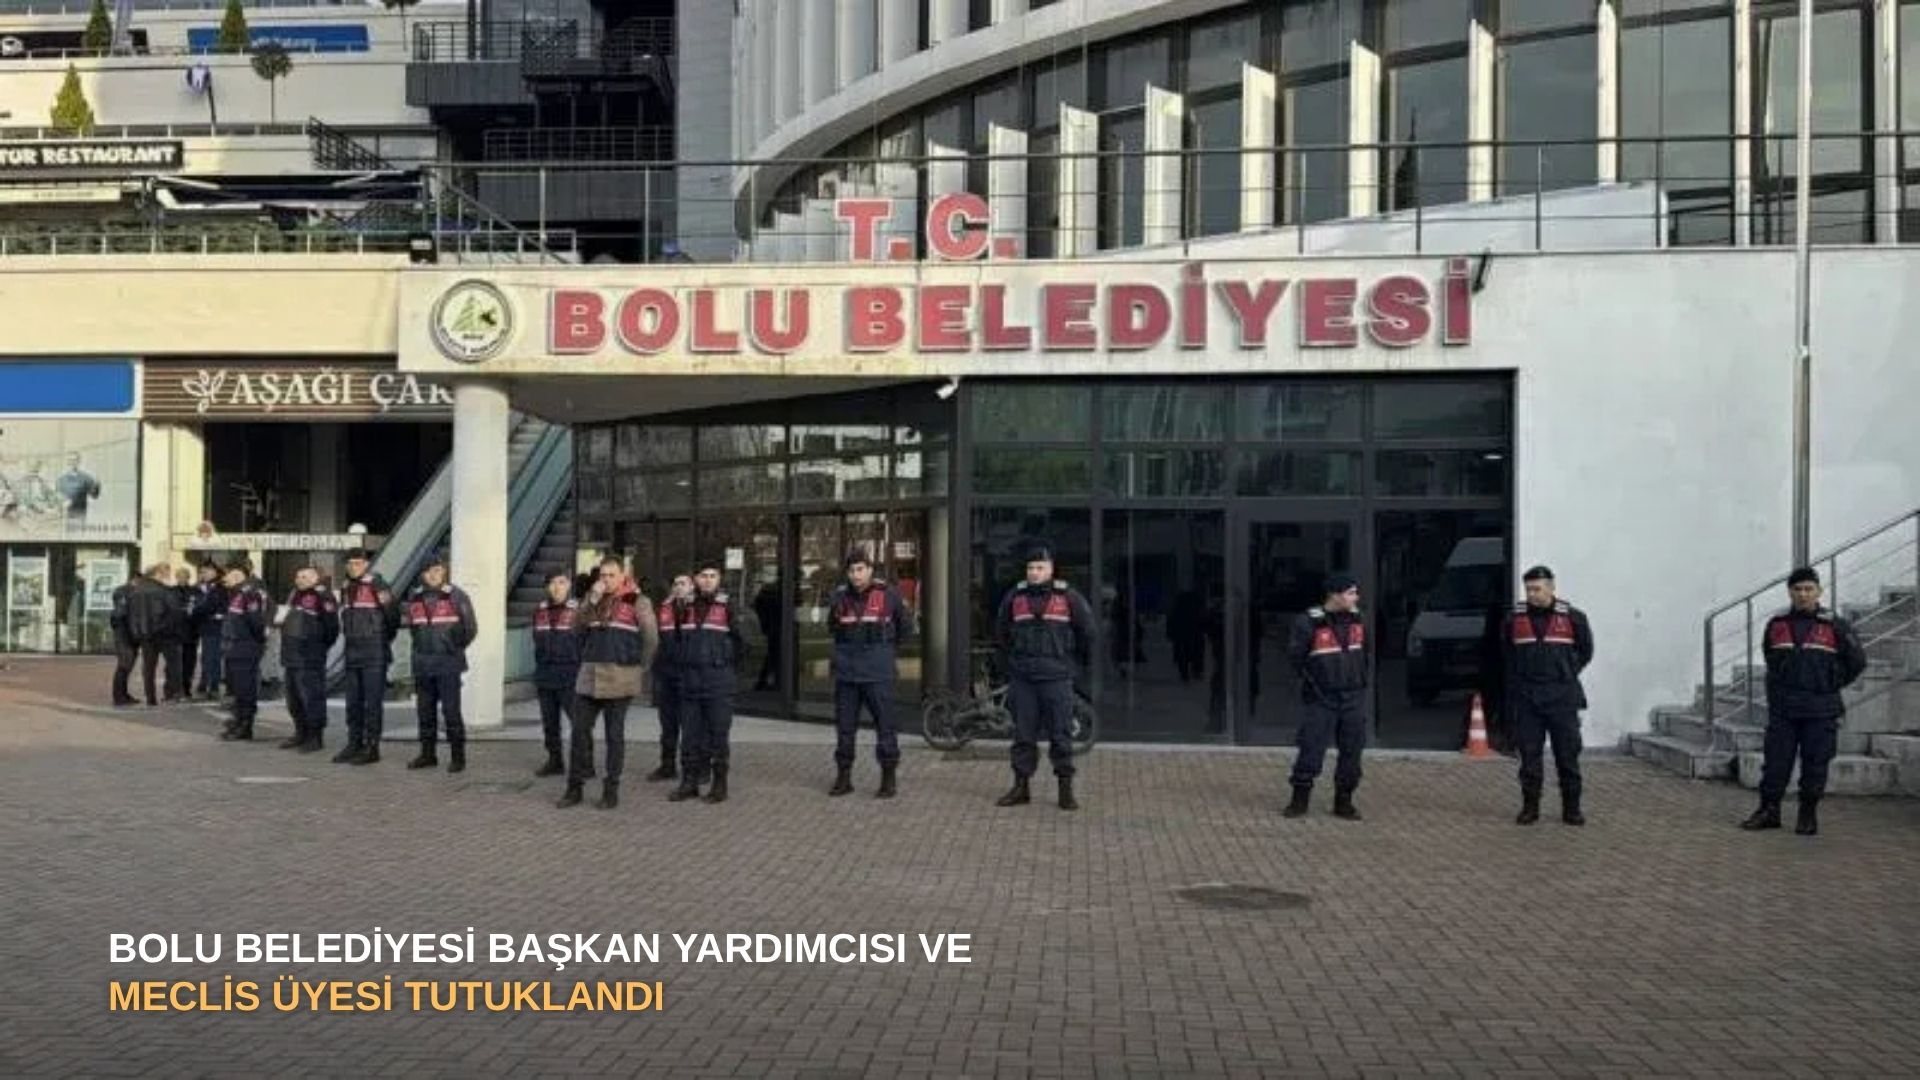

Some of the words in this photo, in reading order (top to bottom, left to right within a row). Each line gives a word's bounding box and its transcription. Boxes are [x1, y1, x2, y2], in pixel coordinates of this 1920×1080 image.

[42, 145, 176, 165] RESTAURANT
[548, 284, 812, 355] BOLU
[845, 258, 1473, 353] BELEDİYESİ
[228, 367, 355, 412] AŞAĞI
